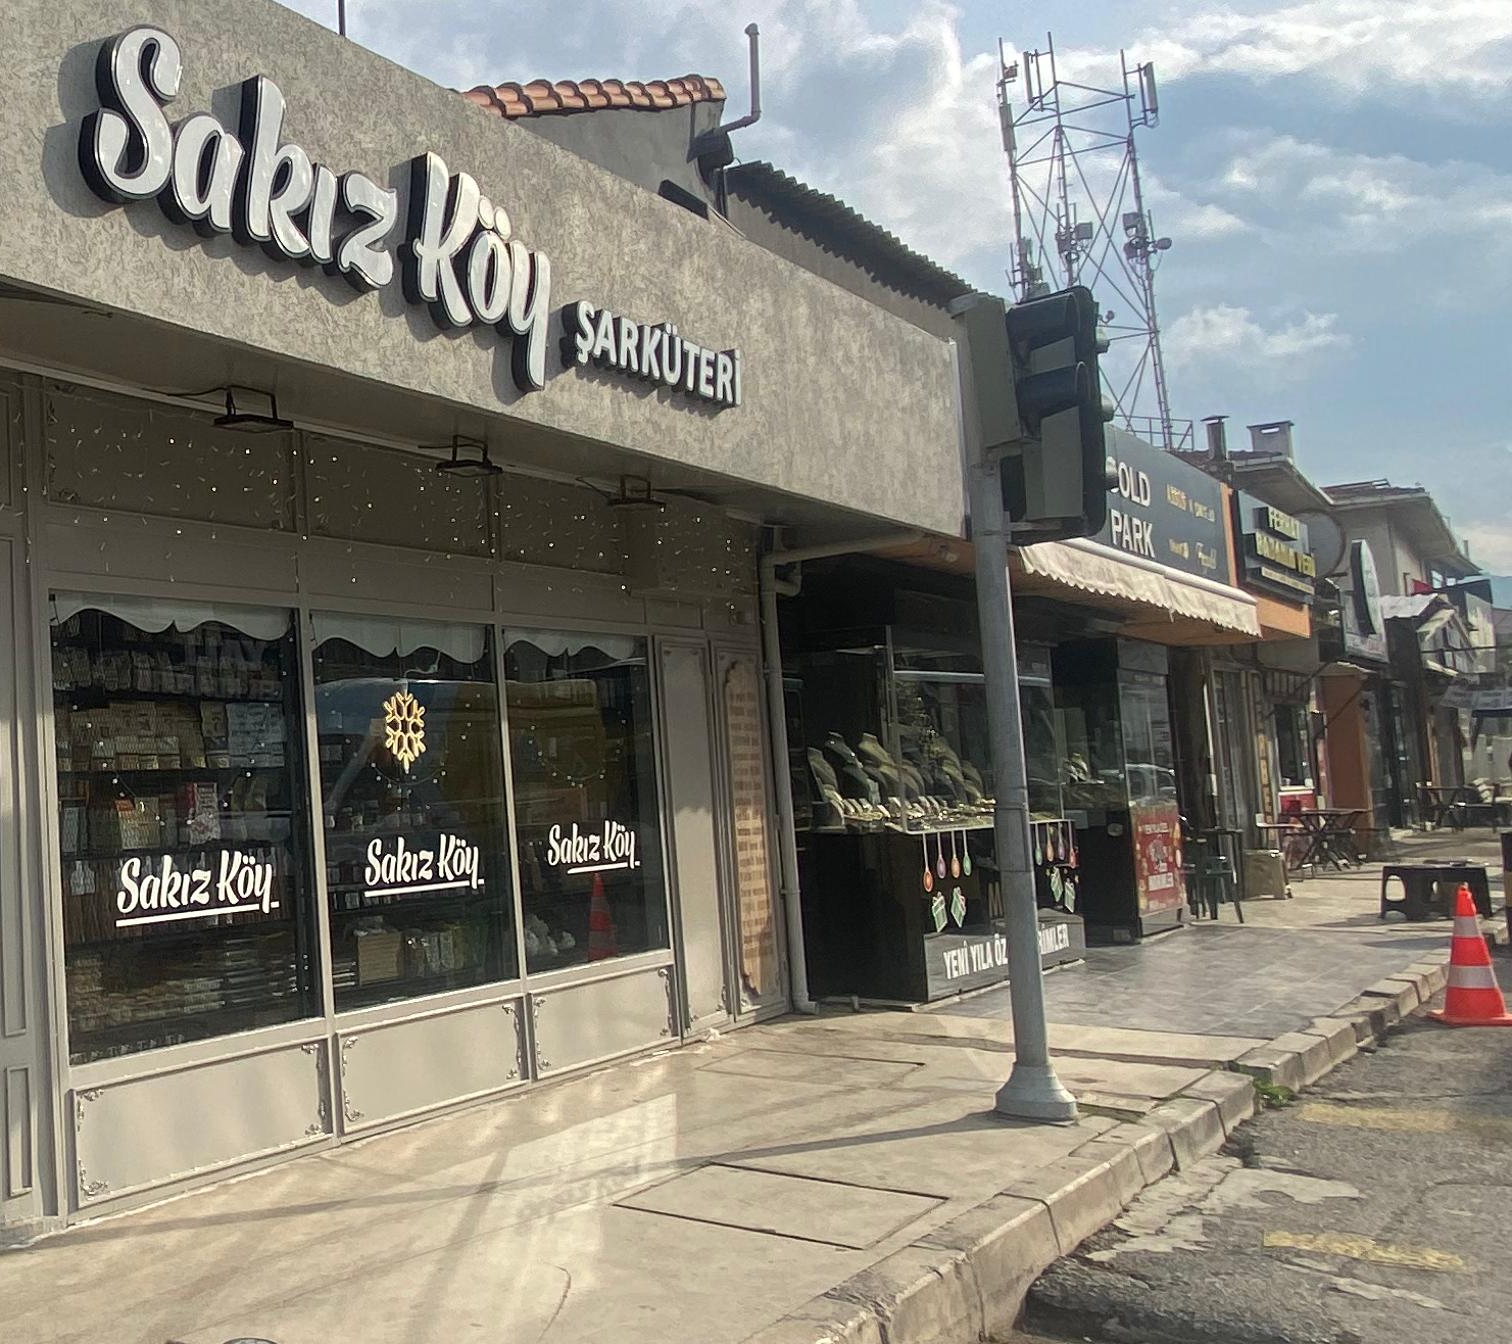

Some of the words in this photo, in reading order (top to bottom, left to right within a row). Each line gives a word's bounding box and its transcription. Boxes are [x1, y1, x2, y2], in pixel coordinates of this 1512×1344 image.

[83, 26, 398, 292] Sakız
[404, 151, 551, 391] Köy
[570, 299, 742, 407] ŞARKÜTERİ
[1110, 508, 1155, 558] PARK
[364, 836, 437, 888] Sakız
[437, 833, 480, 888] Köy
[547, 824, 601, 867] Sakız
[602, 821, 636, 867] Köy
[117, 856, 211, 914] Sakız
[216, 852, 273, 914] Köy
[943, 939, 970, 979] YENİ
[970, 942, 995, 972] YILA
